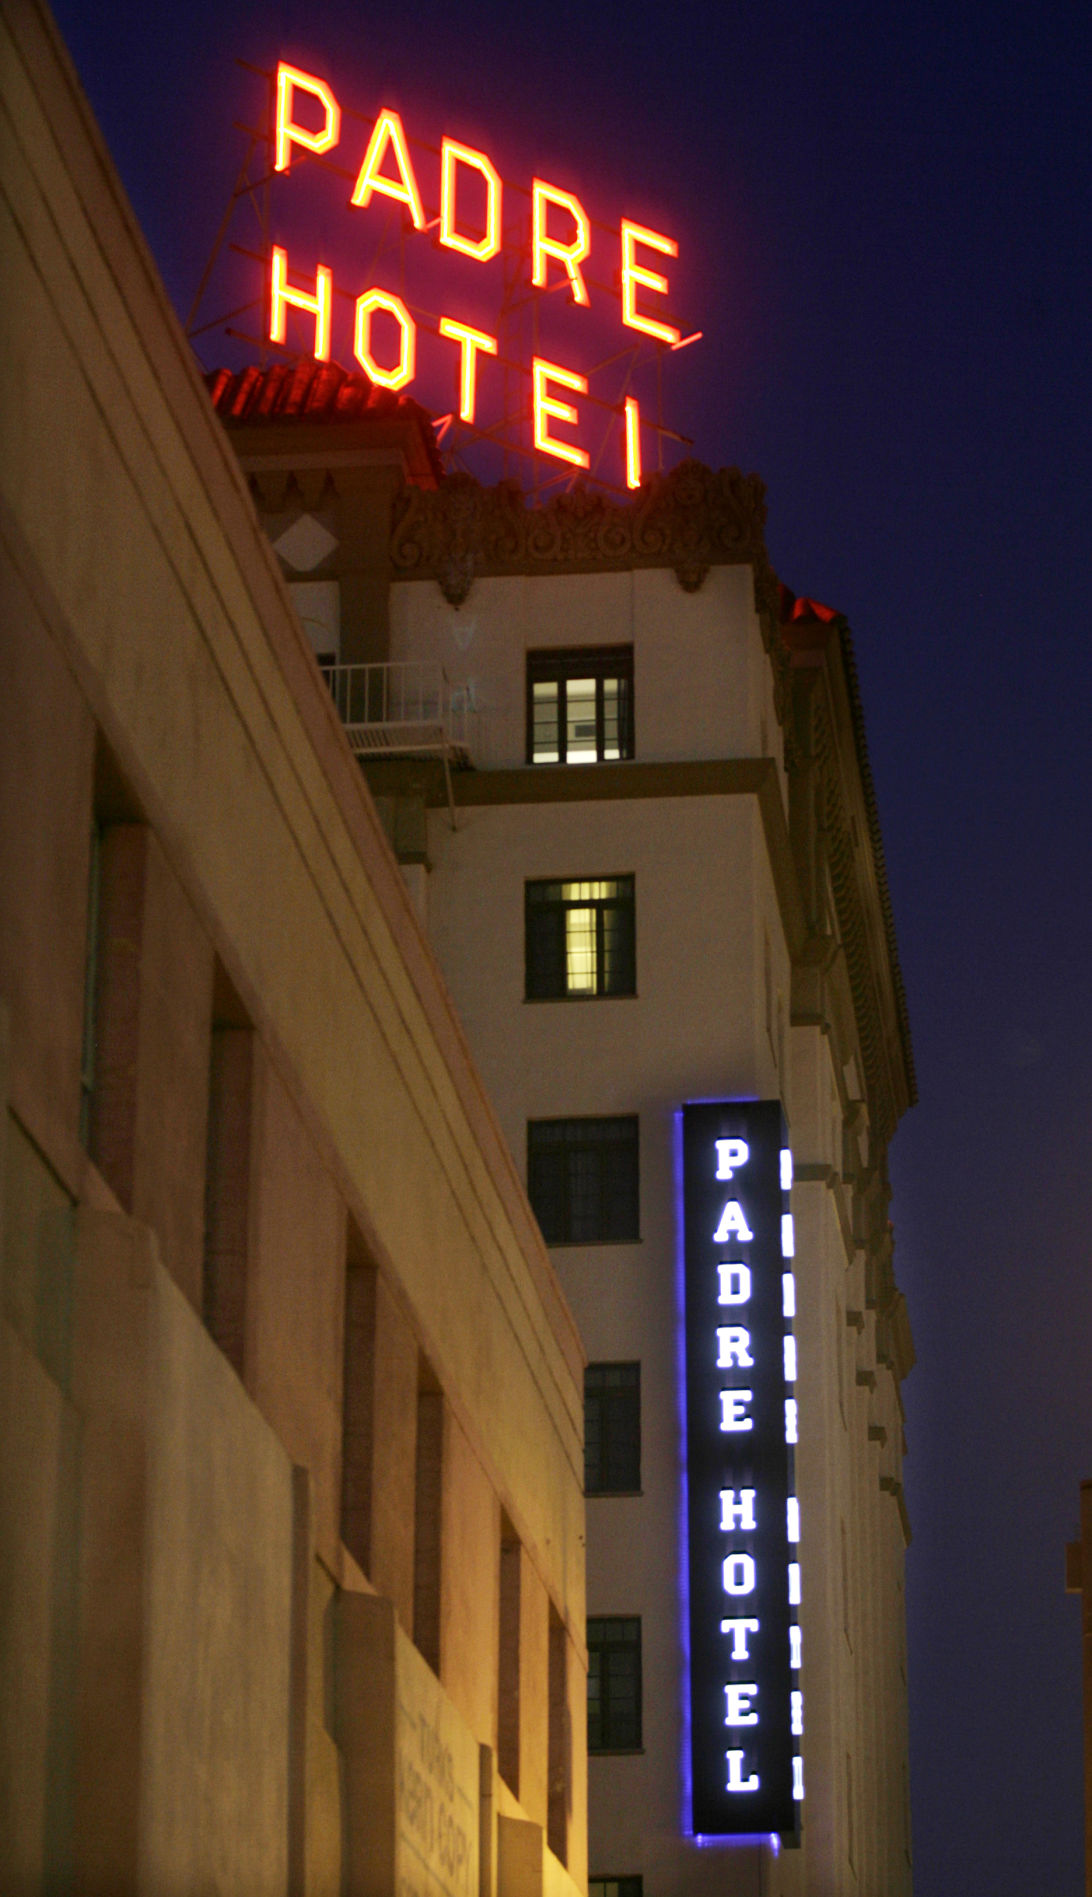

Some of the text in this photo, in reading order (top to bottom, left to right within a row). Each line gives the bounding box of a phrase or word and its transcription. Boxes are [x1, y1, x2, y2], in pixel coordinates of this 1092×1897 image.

[274, 60, 681, 344] PADRE
[713, 1137, 760, 1793] PADRE HOTEL
